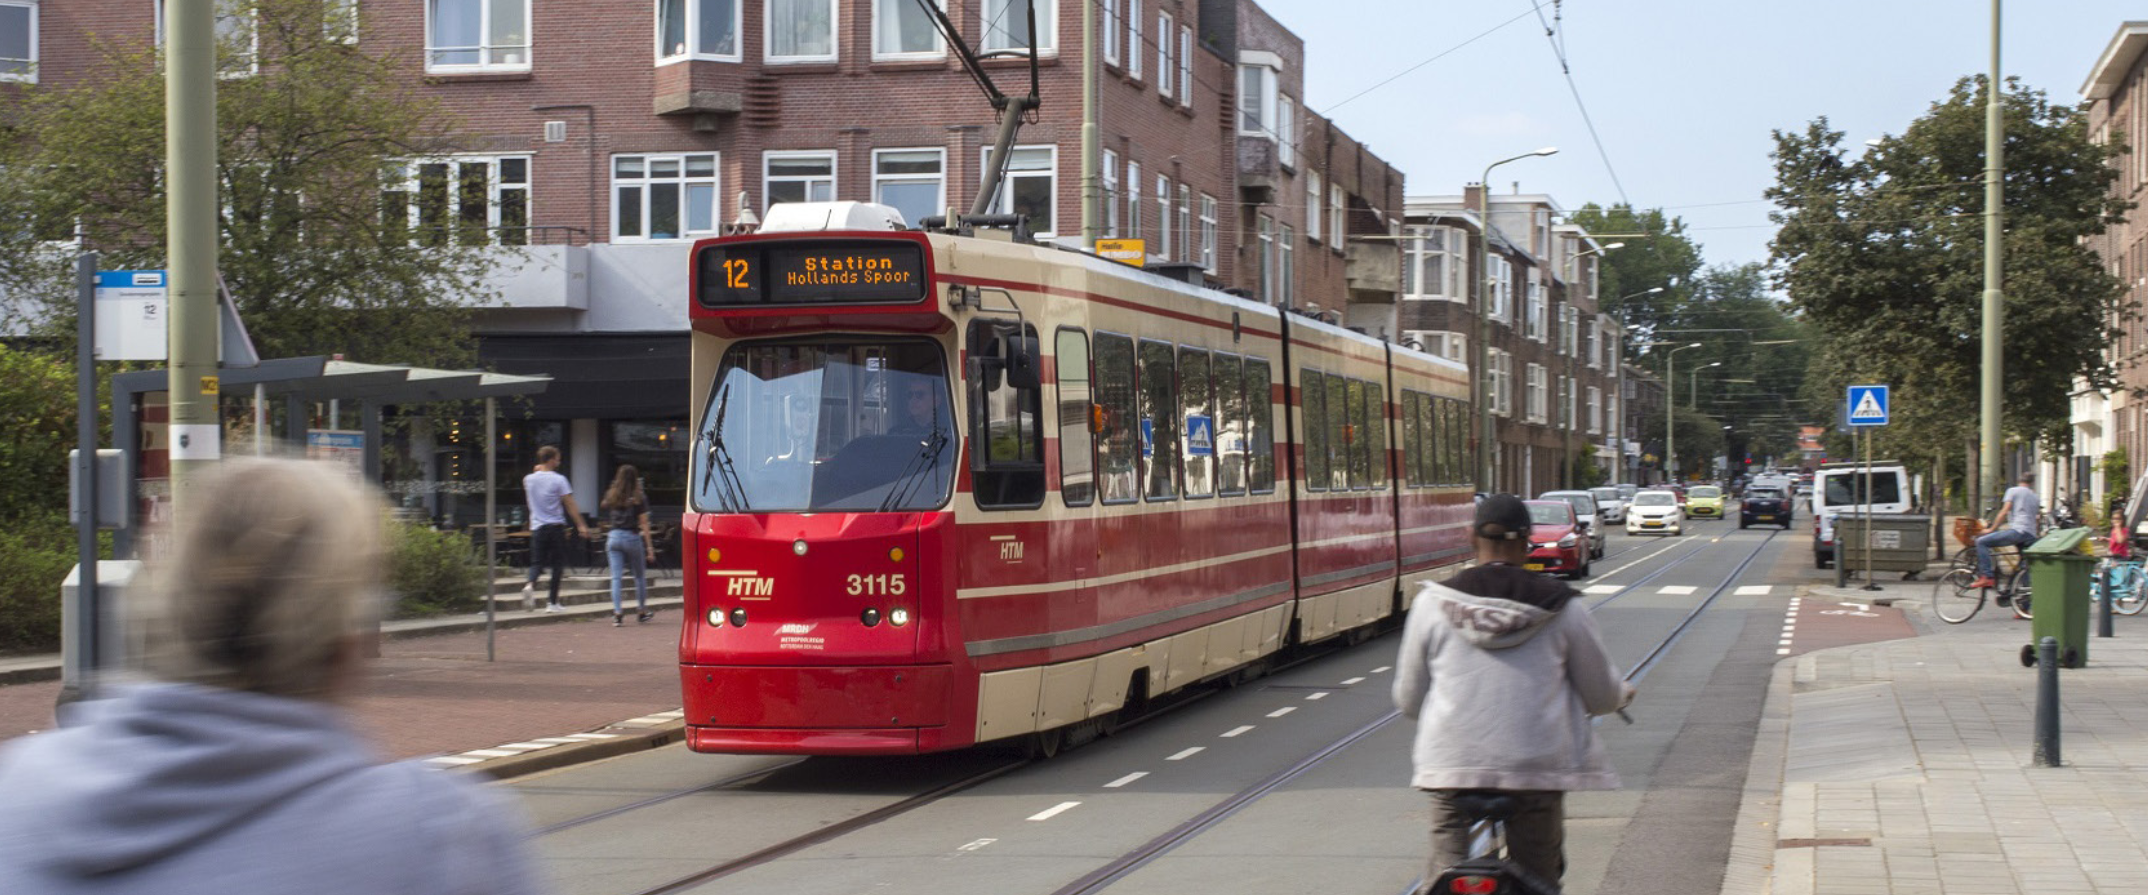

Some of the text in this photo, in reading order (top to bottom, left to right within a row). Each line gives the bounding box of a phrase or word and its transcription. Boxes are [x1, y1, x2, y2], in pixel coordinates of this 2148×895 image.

[722, 258, 750, 289] 12
[804, 256, 893, 272] Station
[787, 269, 911, 286] Hollands Spoor
[1000, 541, 1024, 560] HTM
[727, 577, 775, 596] HTM
[847, 573, 906, 596] 3115
[781, 624, 809, 634] MRDH
